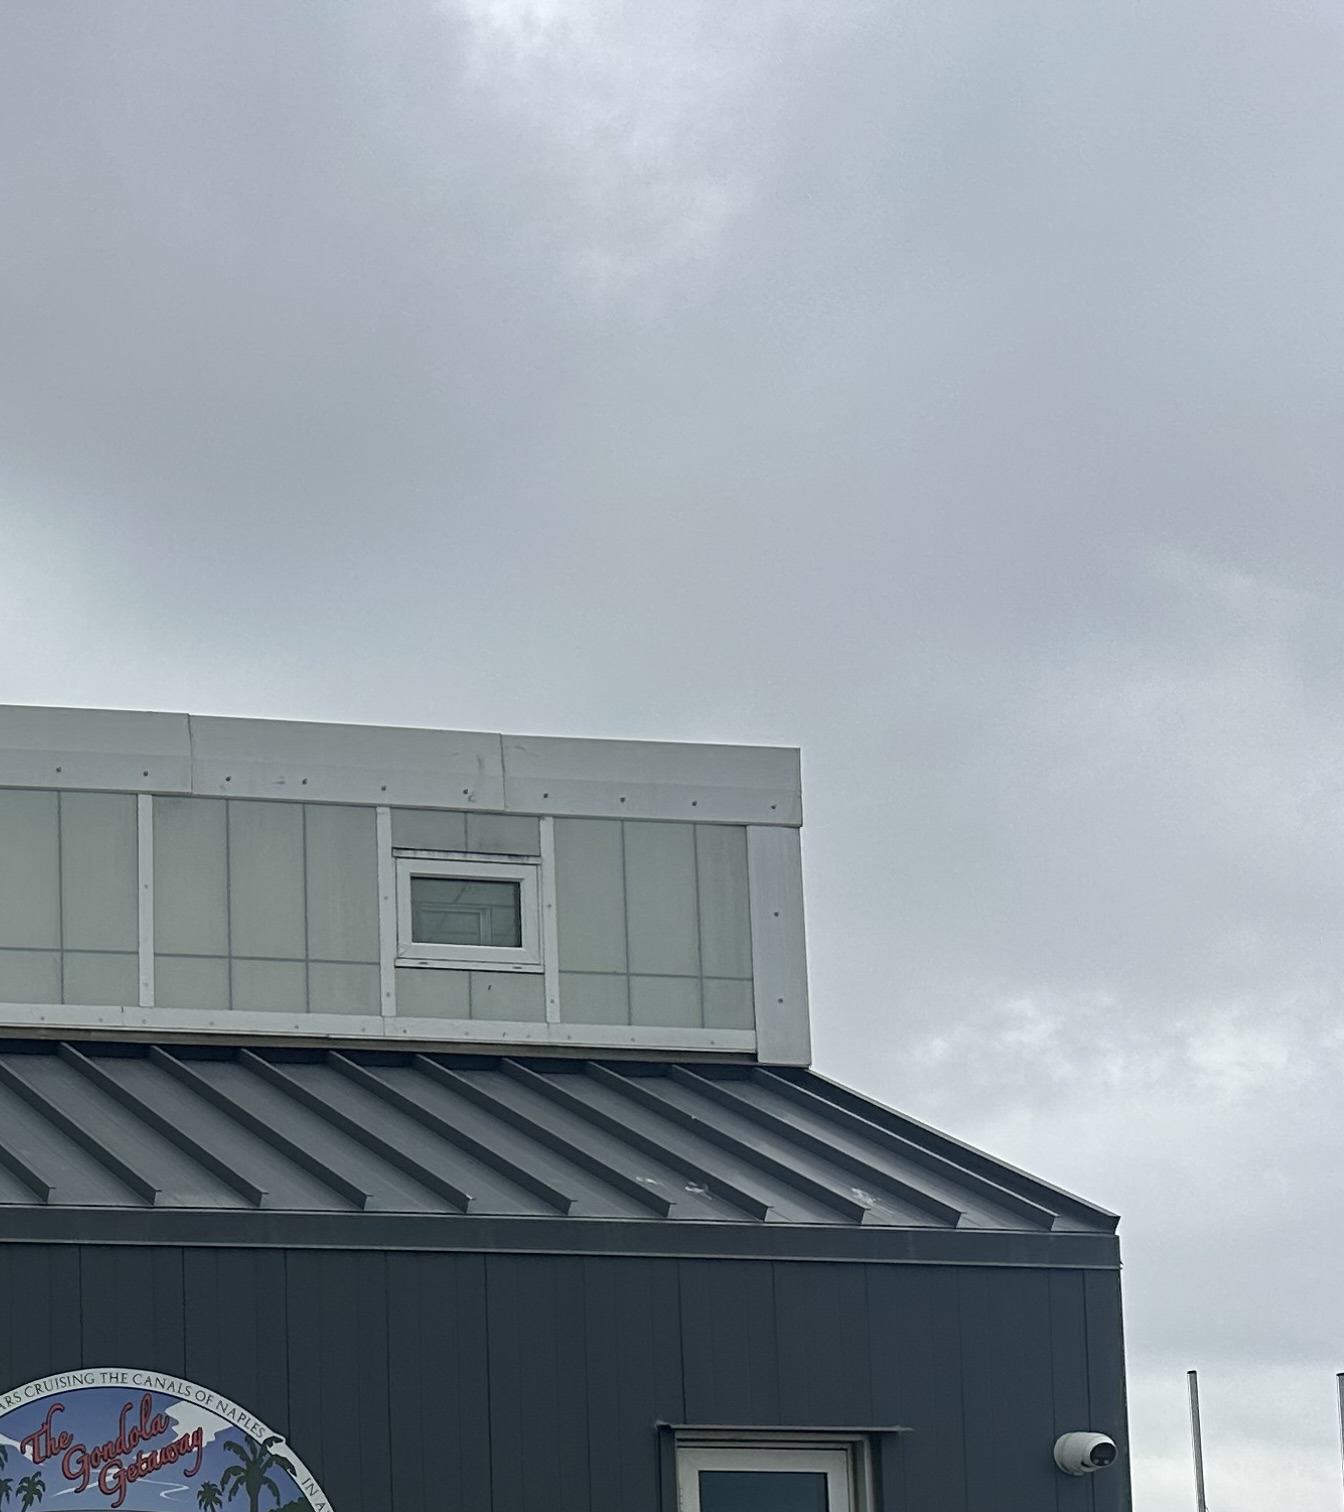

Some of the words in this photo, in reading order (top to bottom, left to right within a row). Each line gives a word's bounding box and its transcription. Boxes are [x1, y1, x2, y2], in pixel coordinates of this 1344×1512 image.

[20, 1402, 74, 1465] The
[24, 1372, 95, 1398] CRUISING
[100, 1372, 128, 1384] THE
[132, 1373, 192, 1397] CANALS
[195, 1389, 214, 1404] OF
[215, 1399, 266, 1439] NAPLES
[301, 1477, 319, 1497] IN
[61, 1392, 170, 1493] Gondola
[98, 1426, 204, 1509] Getaway
